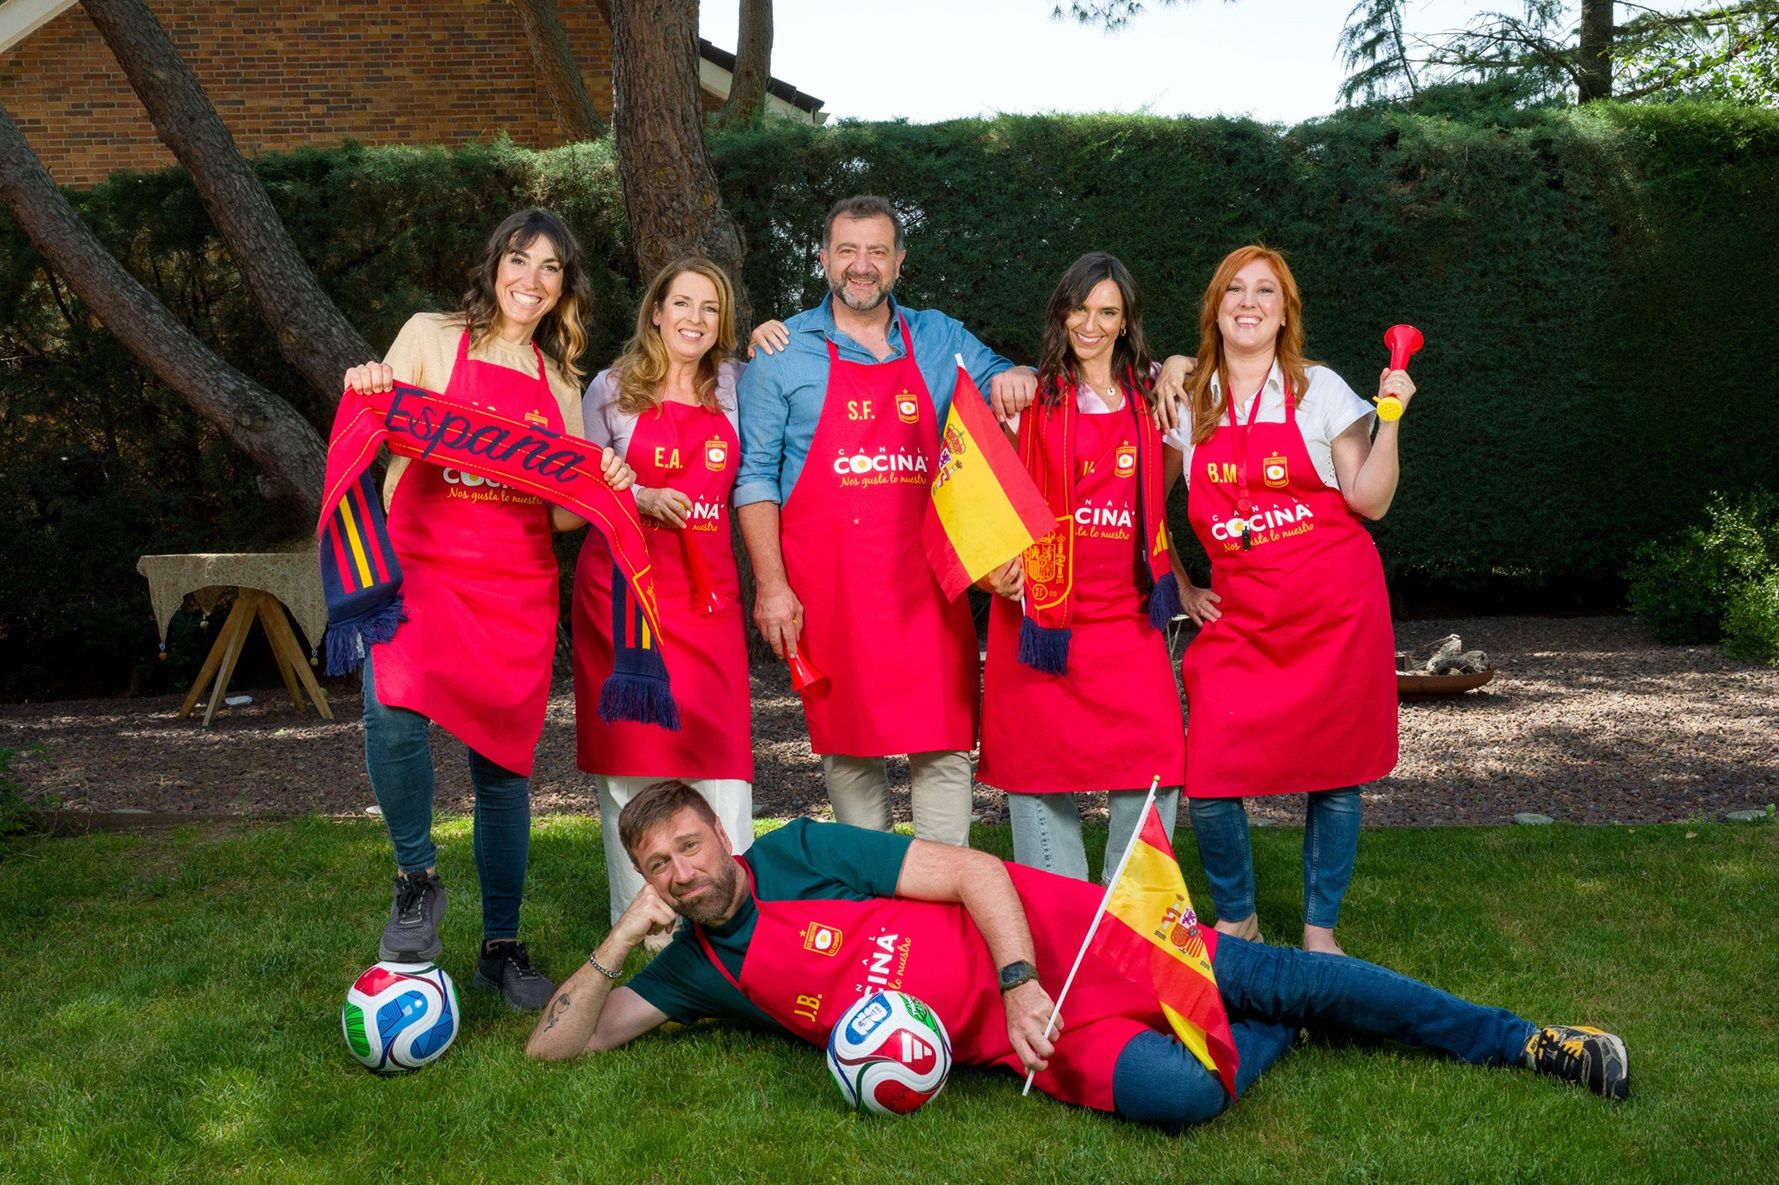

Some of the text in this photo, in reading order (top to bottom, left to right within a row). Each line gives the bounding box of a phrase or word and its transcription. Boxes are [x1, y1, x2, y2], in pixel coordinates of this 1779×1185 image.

[847, 400, 875, 420] S.F.
[385, 386, 586, 482] España
[655, 446, 684, 469] E.A.
[834, 454, 927, 474] COCINA
[840, 476, 859, 488] Nos
[862, 473, 889, 488] gusta
[890, 472, 898, 483] lo
[448, 487, 469, 498] Nos
[471, 489, 500, 504] gusta
[501, 490, 510, 502] lo
[1075, 507, 1132, 528] CINA
[1101, 528, 1130, 540] nuestro
[1282, 521, 1314, 538] nuestro
[896, 937, 912, 976] nuestro
[794, 994, 823, 1023] J.B.
